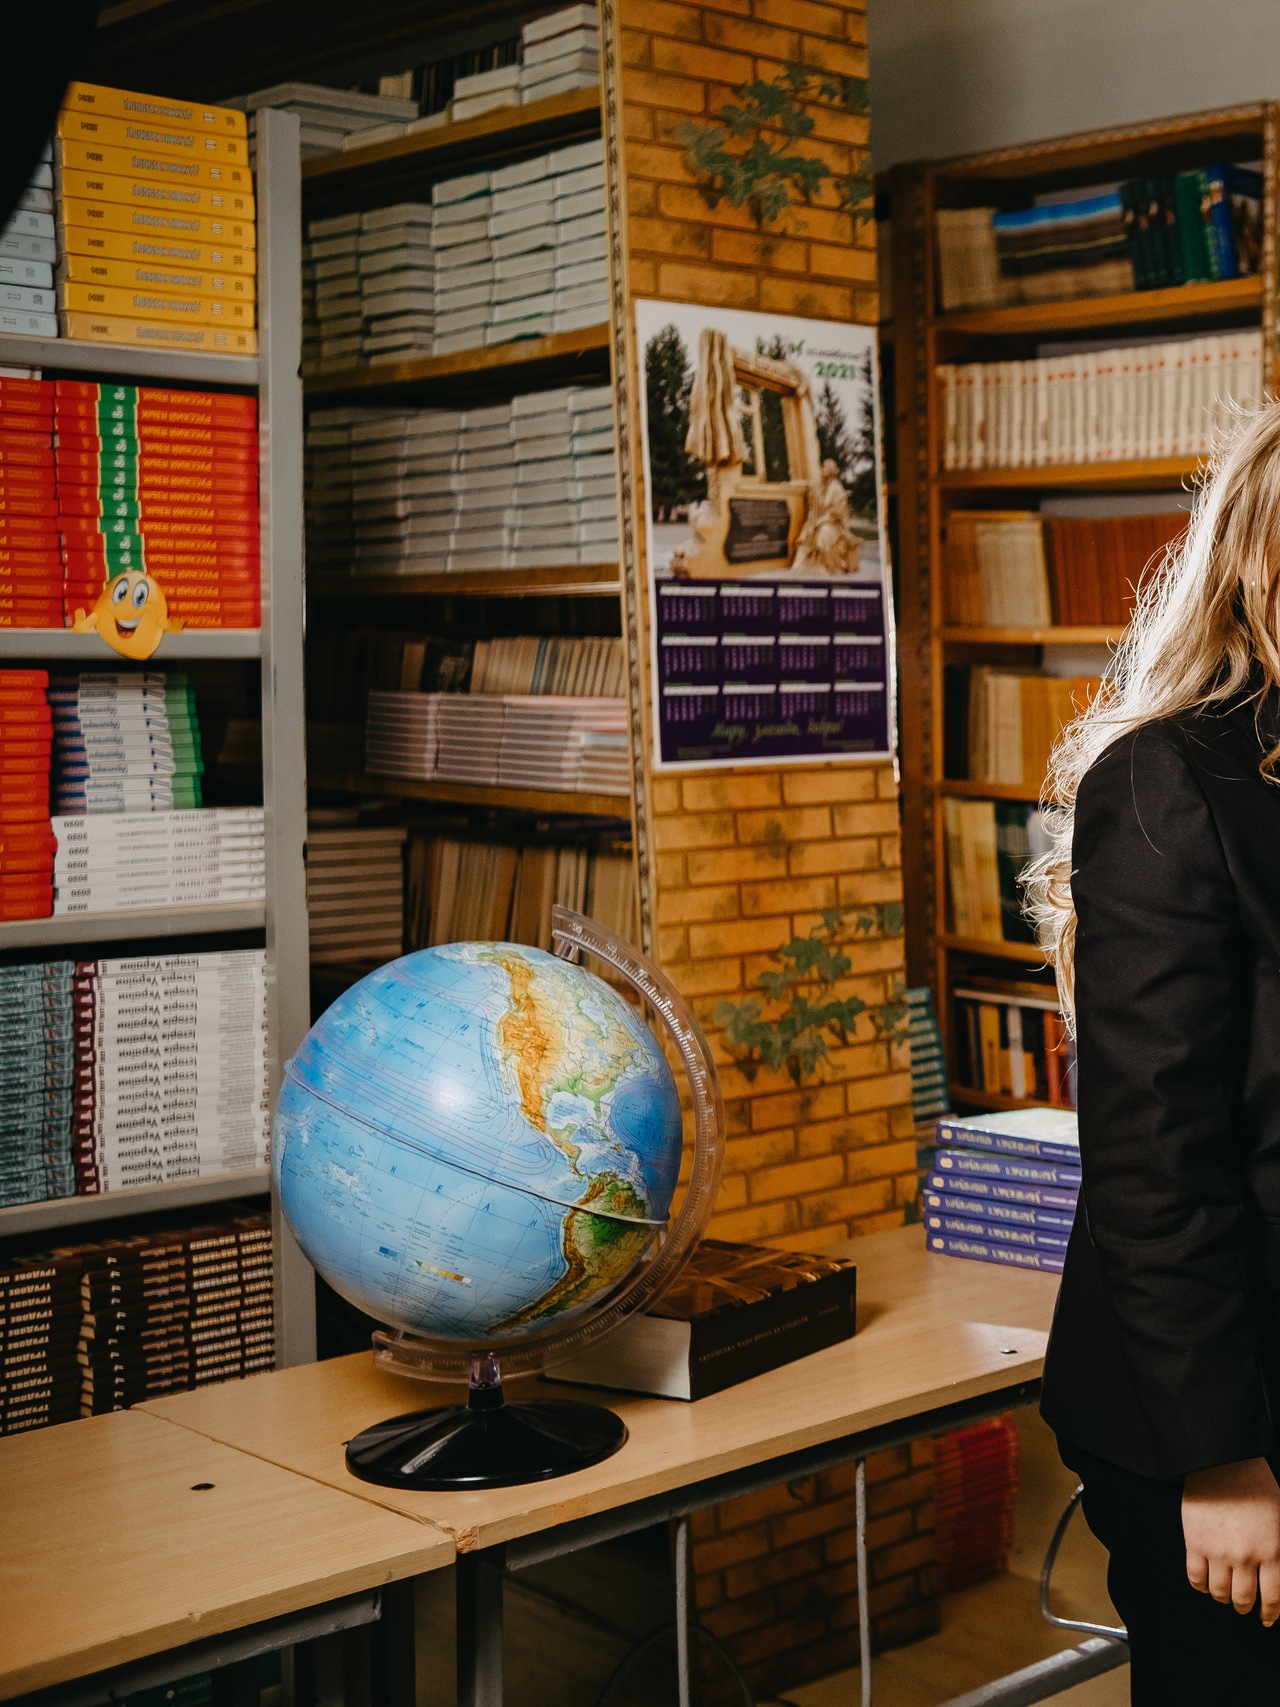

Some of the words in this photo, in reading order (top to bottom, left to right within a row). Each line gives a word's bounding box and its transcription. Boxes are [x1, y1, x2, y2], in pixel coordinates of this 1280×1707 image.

[814, 361, 856, 380] 2021
[120, 959, 161, 974] України
[164, 955, 199, 969] Історія
[115, 974, 157, 989] України
[160, 969, 195, 984] Історія
[118, 988, 160, 1003] України
[163, 984, 198, 998] Історія
[117, 1002, 159, 1018] України
[162, 998, 197, 1013] Історія
[117, 1016, 159, 1032] України
[162, 1012, 197, 1027] Історія
[116, 1031, 158, 1046] України
[161, 1027, 196, 1041] Історія
[118, 1045, 160, 1060] України
[163, 1041, 198, 1055] Історія
[117, 1059, 159, 1075] України
[162, 1055, 197, 1070] Історія
[118, 1073, 159, 1088] України
[162, 1069, 198, 1084] Історія
[118, 1088, 160, 1103] України
[163, 1084, 198, 1098] Історія
[117, 1101, 159, 1117] України
[162, 1097, 197, 1112] Історія
[115, 1115, 157, 1130] України
[160, 1111, 195, 1125] Історія
[118, 1129, 160, 1144] України
[163, 1125, 199, 1139] Історія
[117, 1144, 159, 1159] України
[162, 1140, 197, 1154] Історія
[121, 1157, 163, 1173] України
[165, 1153, 201, 1168] Історія
[122, 1171, 162, 1186] України
[165, 1167, 200, 1181] Історія
